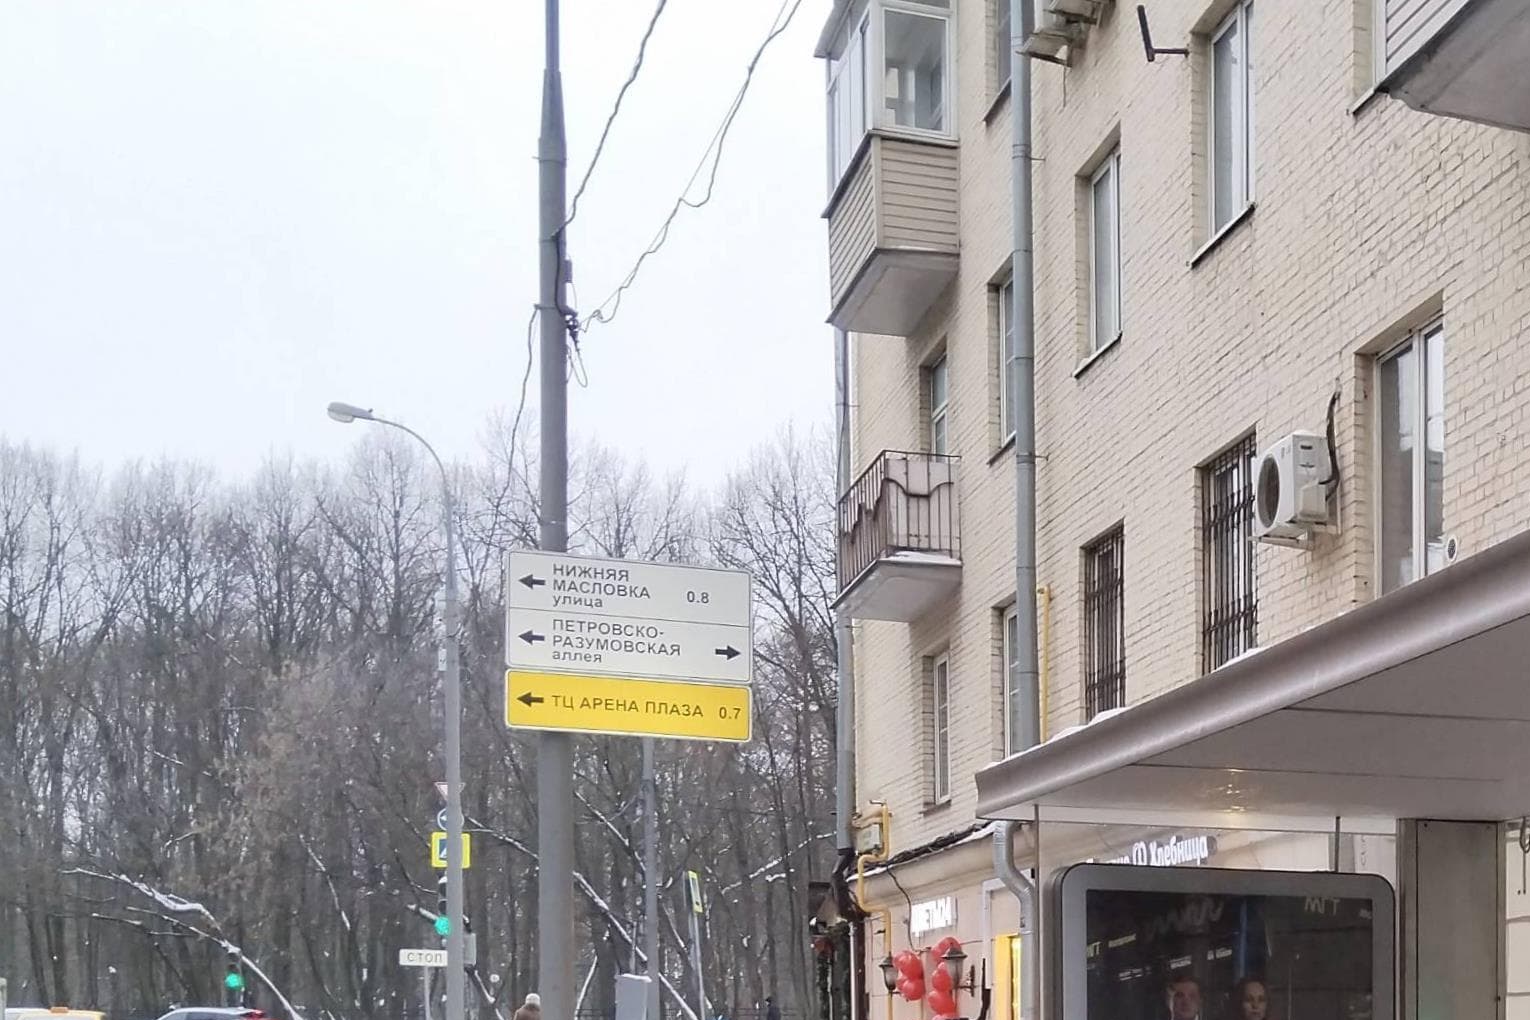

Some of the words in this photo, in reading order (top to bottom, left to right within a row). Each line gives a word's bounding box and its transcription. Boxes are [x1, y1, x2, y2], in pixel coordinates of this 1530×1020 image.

[553, 563, 629, 582] НИЖНЯЯ
[553, 579, 650, 599] МАСЛОВКА
[686, 590, 709, 604] 0.8
[552, 595, 603, 608] улица
[553, 619, 664, 639] ПЕТРОВСКО-
[552, 636, 681, 656] РАЗУМОВСКАЯ
[552, 651, 602, 663] аллея
[552, 695, 574, 711] ТЦ
[580, 697, 639, 713] АРЕНА
[645, 701, 703, 718] ПЛАЗА
[718, 706, 741, 720] 0.7
[407, 952, 442, 963] СТОП
